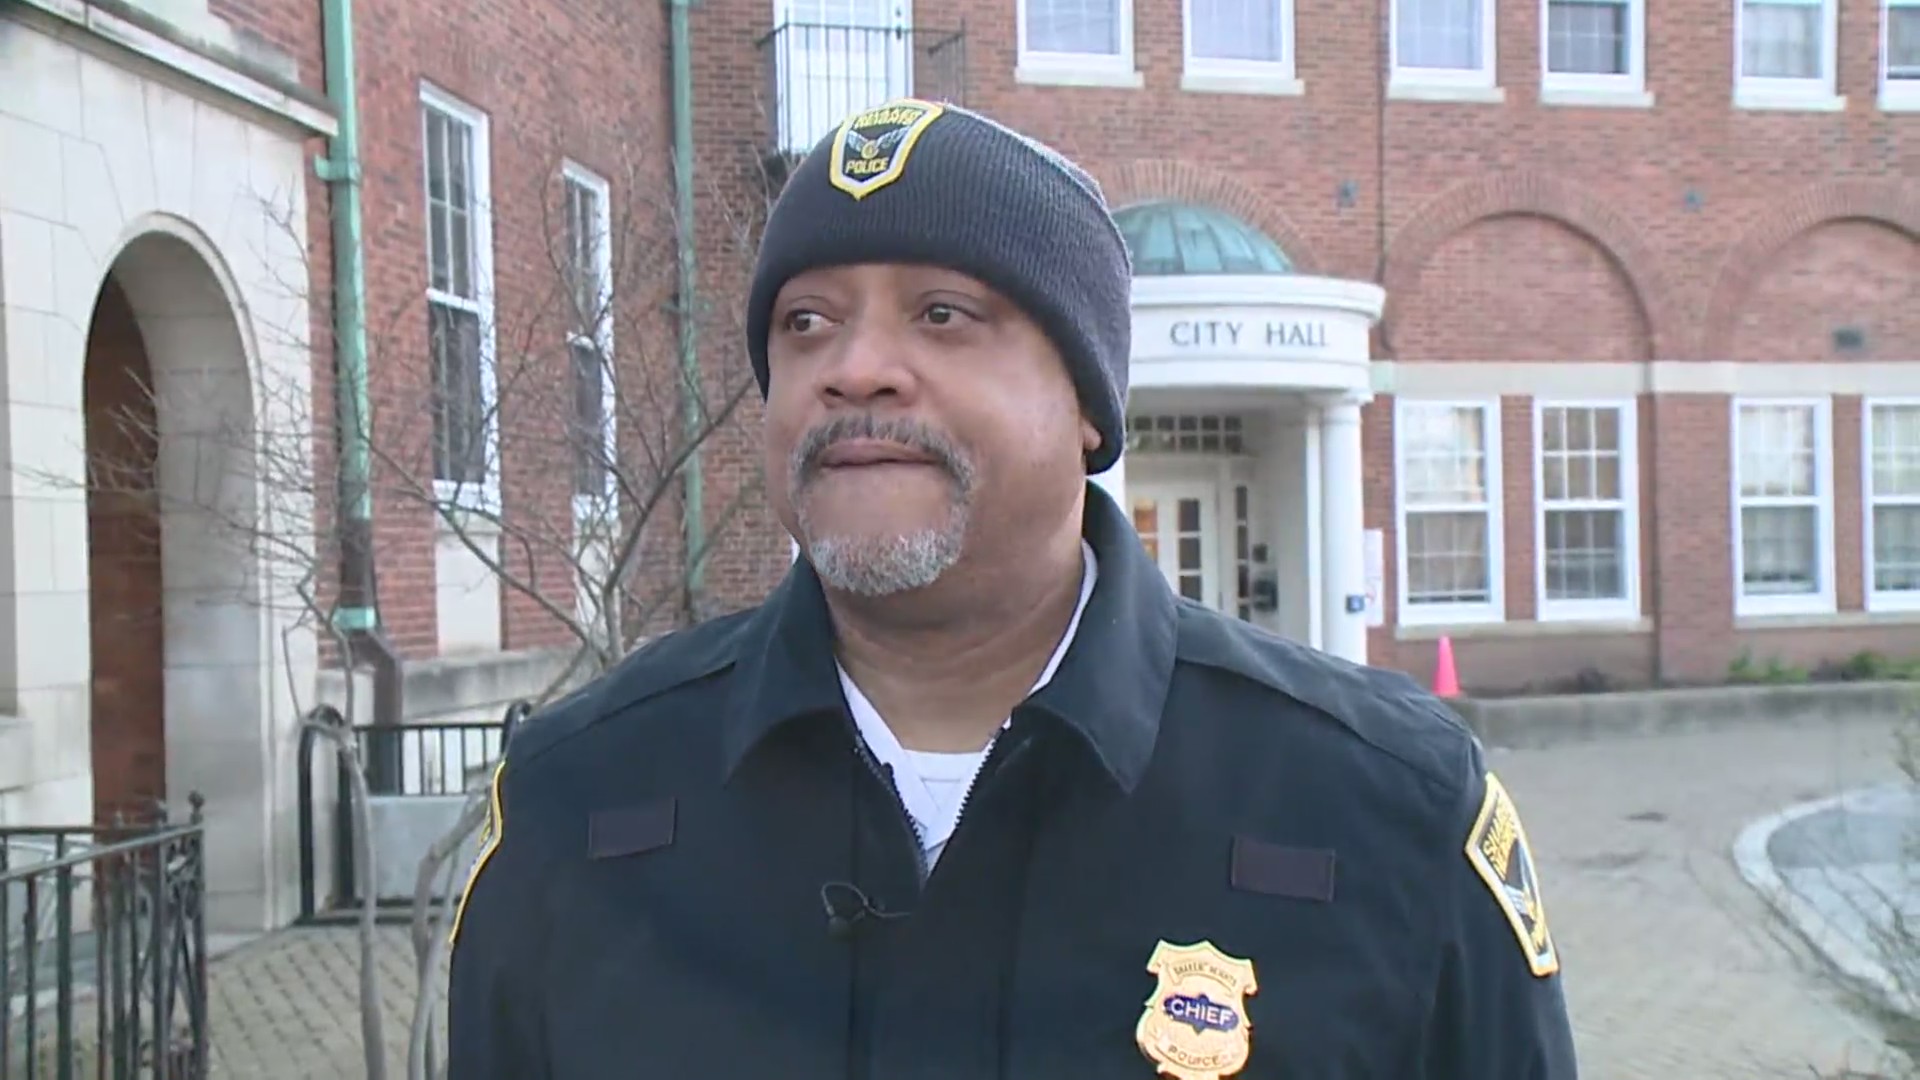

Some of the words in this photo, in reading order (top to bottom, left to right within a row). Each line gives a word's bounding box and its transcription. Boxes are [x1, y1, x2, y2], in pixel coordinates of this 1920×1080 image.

[845, 158, 889, 174] POLICE
[1169, 320, 1244, 347] CITY
[1265, 321, 1329, 348] HALL
[1170, 999, 1234, 1026] CHIEF
[1167, 1044, 1221, 1067] POLICE
